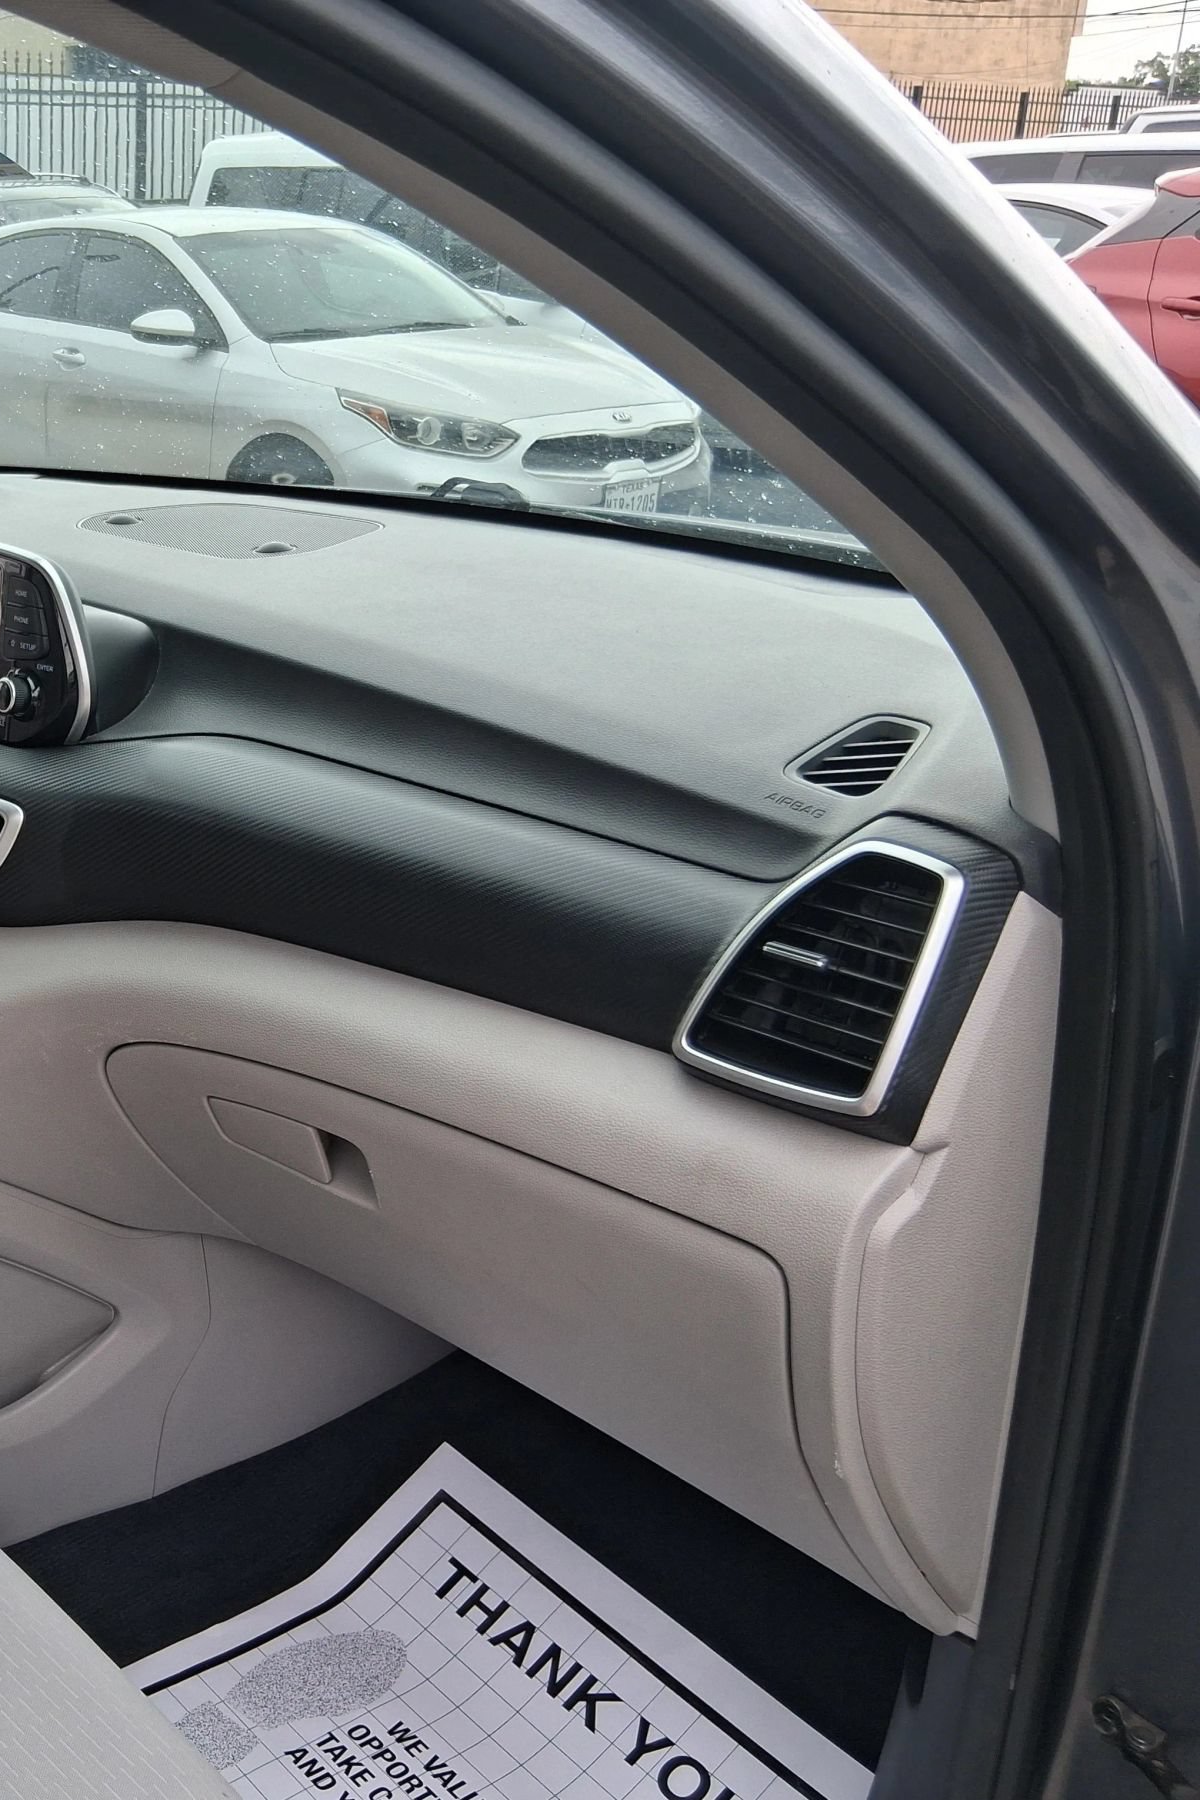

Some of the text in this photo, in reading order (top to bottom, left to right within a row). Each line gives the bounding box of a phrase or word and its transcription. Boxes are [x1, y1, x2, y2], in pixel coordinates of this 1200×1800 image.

[764, 792, 827, 819] AIRBAG
[434, 1556, 736, 1800] THANK YO
[315, 1731, 376, 1788] TAKE
[347, 1724, 440, 1800] OPPORT
[386, 1720, 430, 1758] WE
[284, 1747, 337, 1791] AND
